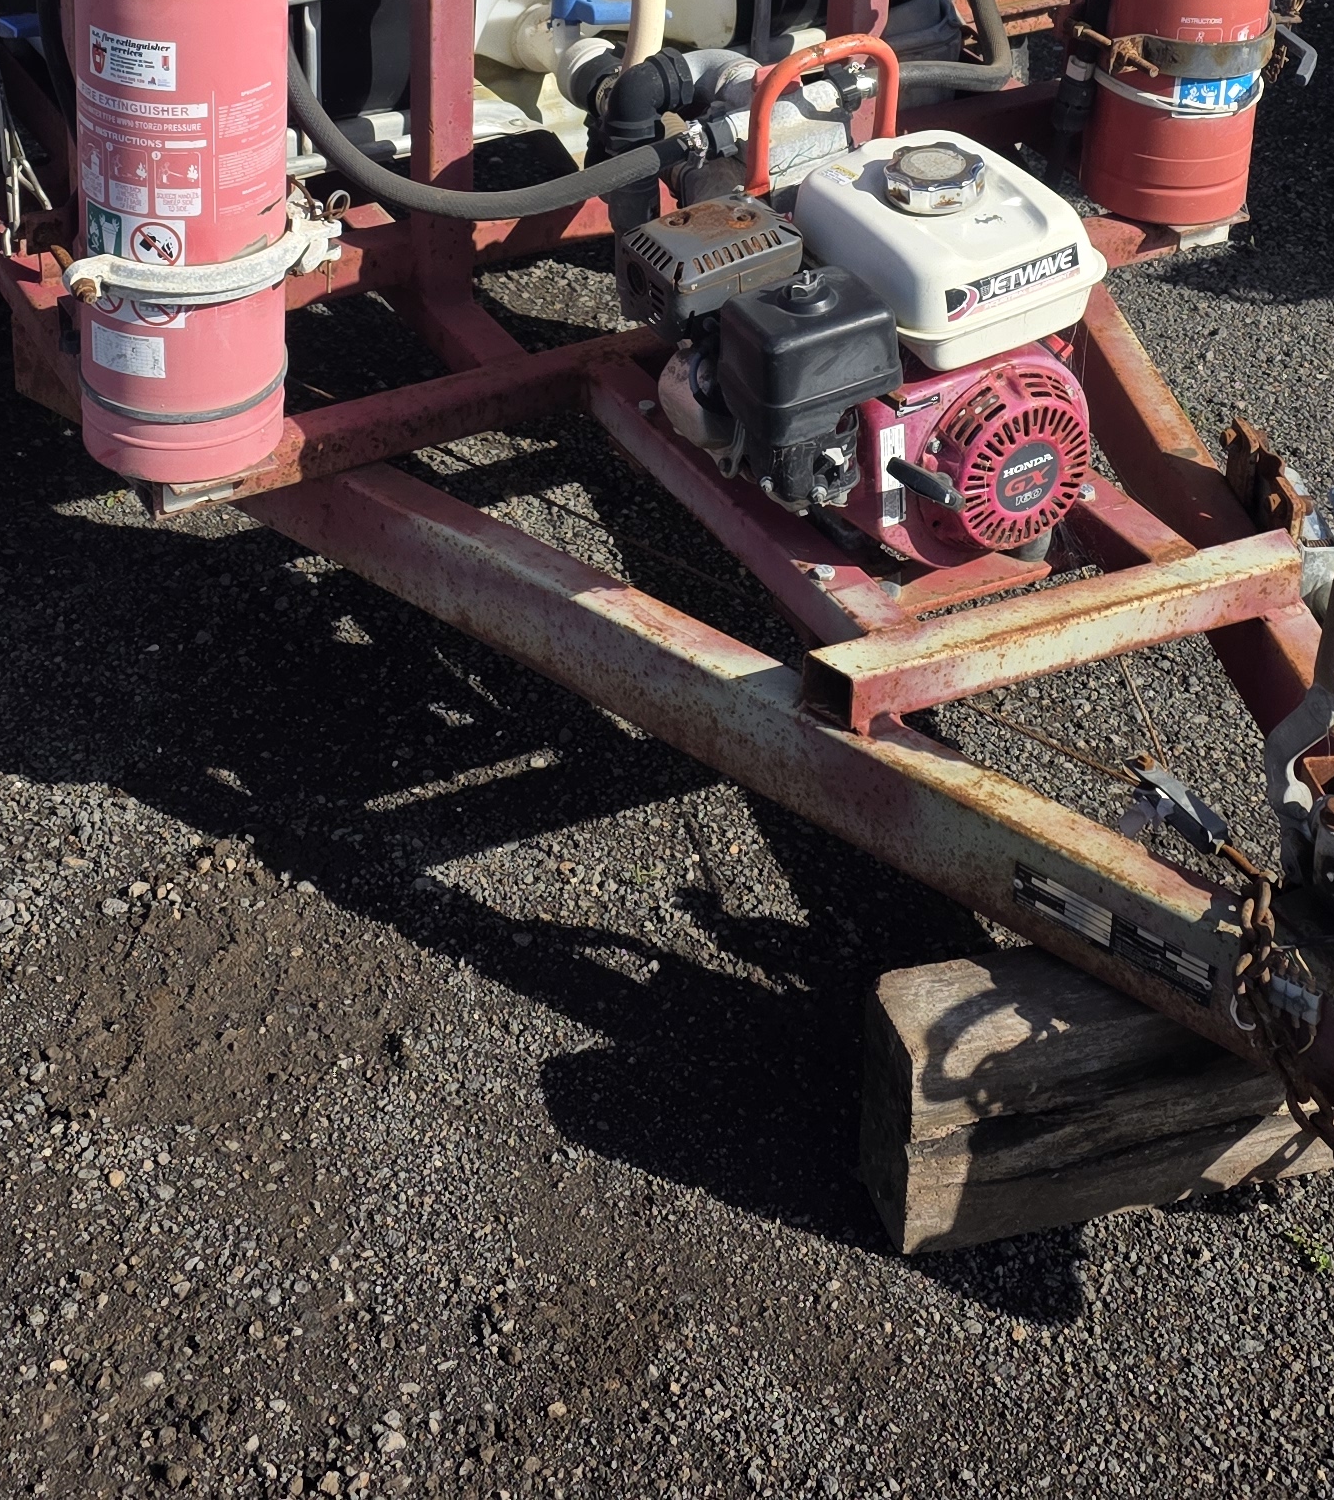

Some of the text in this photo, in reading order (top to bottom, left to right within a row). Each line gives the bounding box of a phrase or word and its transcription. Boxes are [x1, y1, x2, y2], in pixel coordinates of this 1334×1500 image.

[1181, 16, 1223, 24] INSTRUCTIONS
[101, 32, 171, 52] fire extinguisher
[81, 83, 189, 116] FIRE EXTINGUISHER
[135, 120, 163, 131] STORED
[163, 122, 201, 132] PRESSURE
[95, 127, 163, 148] INSTRUCTIONS
[981, 246, 1073, 300] JETWAVE
[1003, 453, 1053, 478] HONDA
[1004, 464, 1052, 497] GX
[1015, 488, 1043, 506] 160
